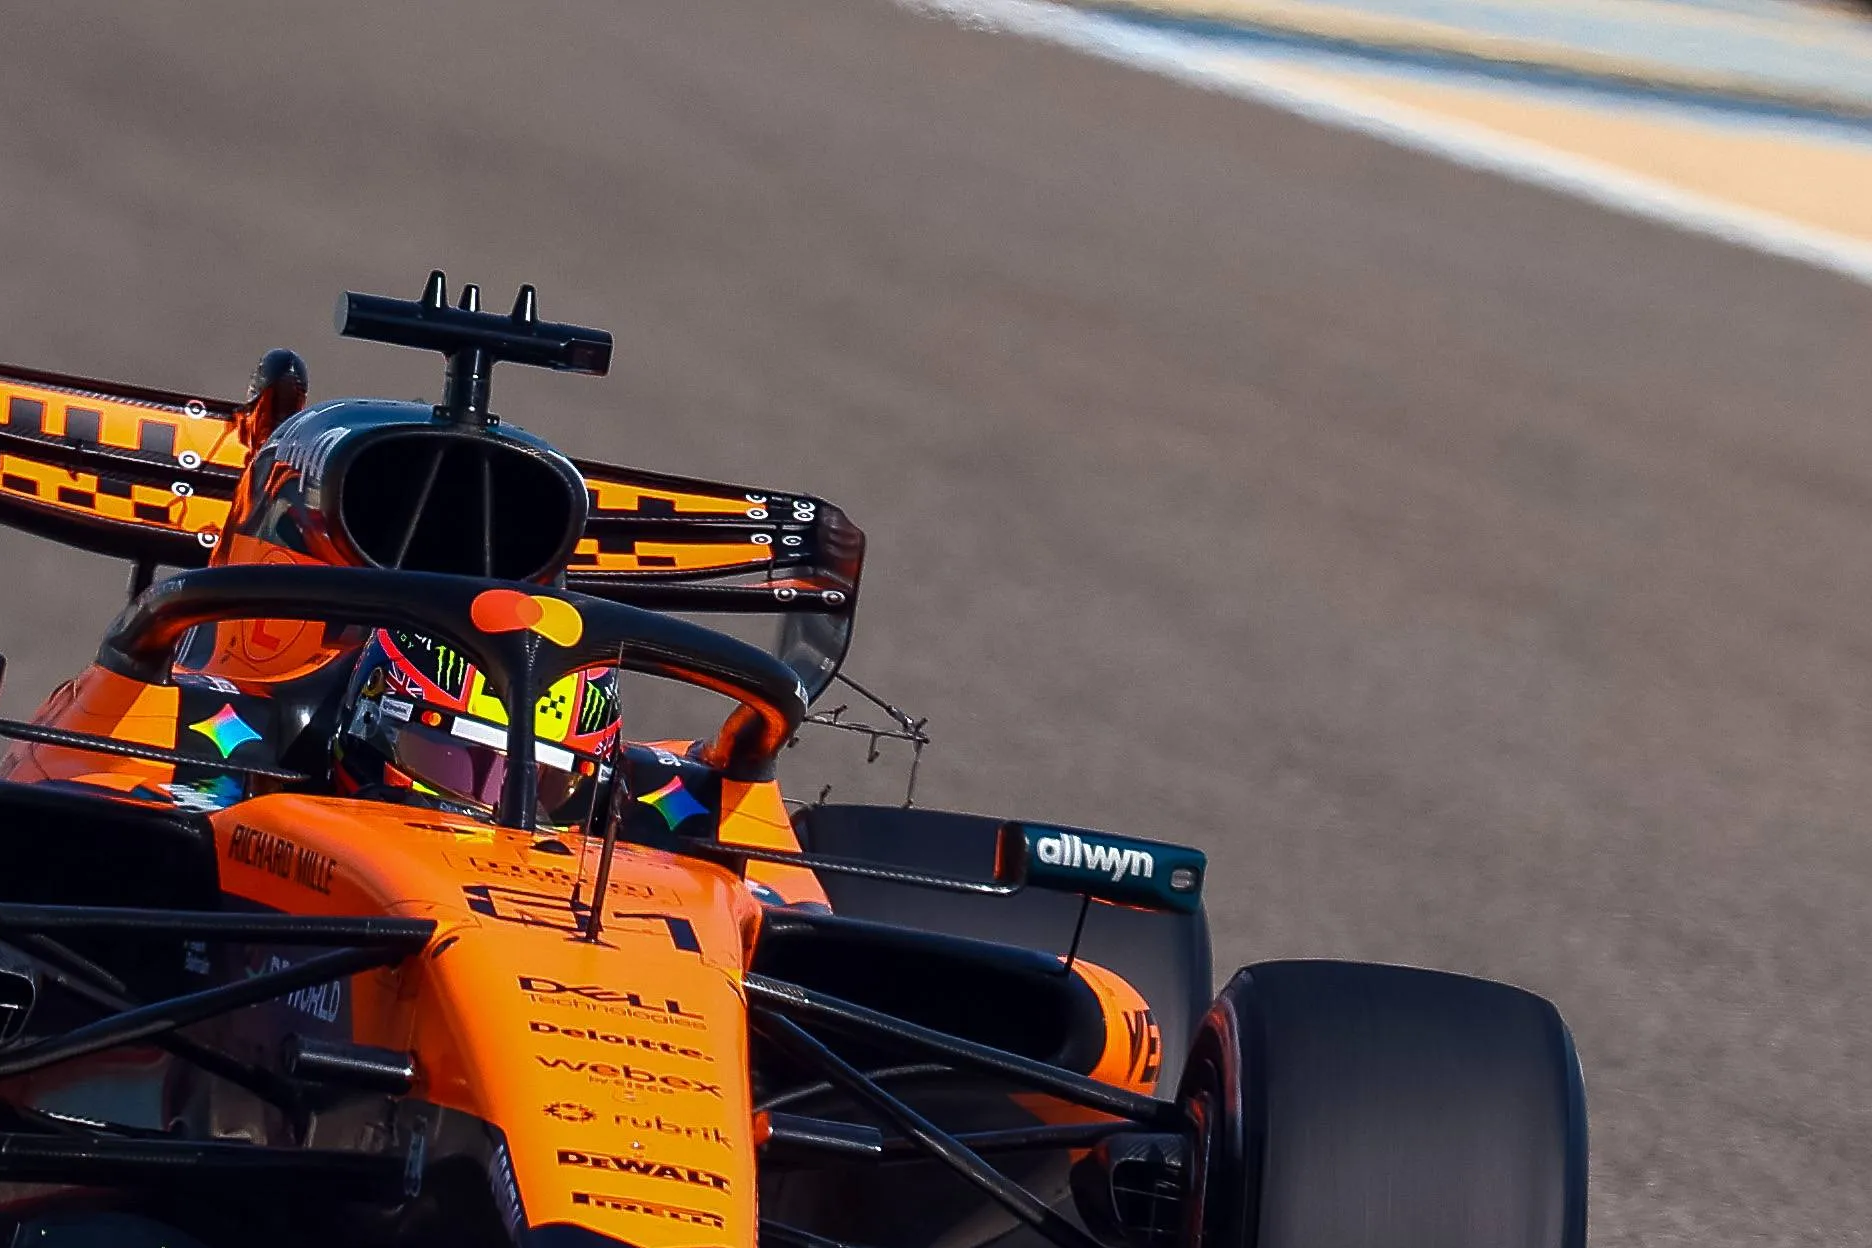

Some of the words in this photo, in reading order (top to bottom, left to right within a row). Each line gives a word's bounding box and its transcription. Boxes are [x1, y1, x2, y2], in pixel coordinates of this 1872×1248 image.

[229, 823, 295, 880] RICHARD
[295, 847, 338, 896] MILLE
[1036, 832, 1155, 883] allwyn
[518, 975, 705, 1021] DELL
[529, 1020, 715, 1063] Deloitte.
[535, 1054, 724, 1100] webex
[614, 1114, 733, 1150] rubrik
[572, 1191, 726, 1230] PIRELLI
